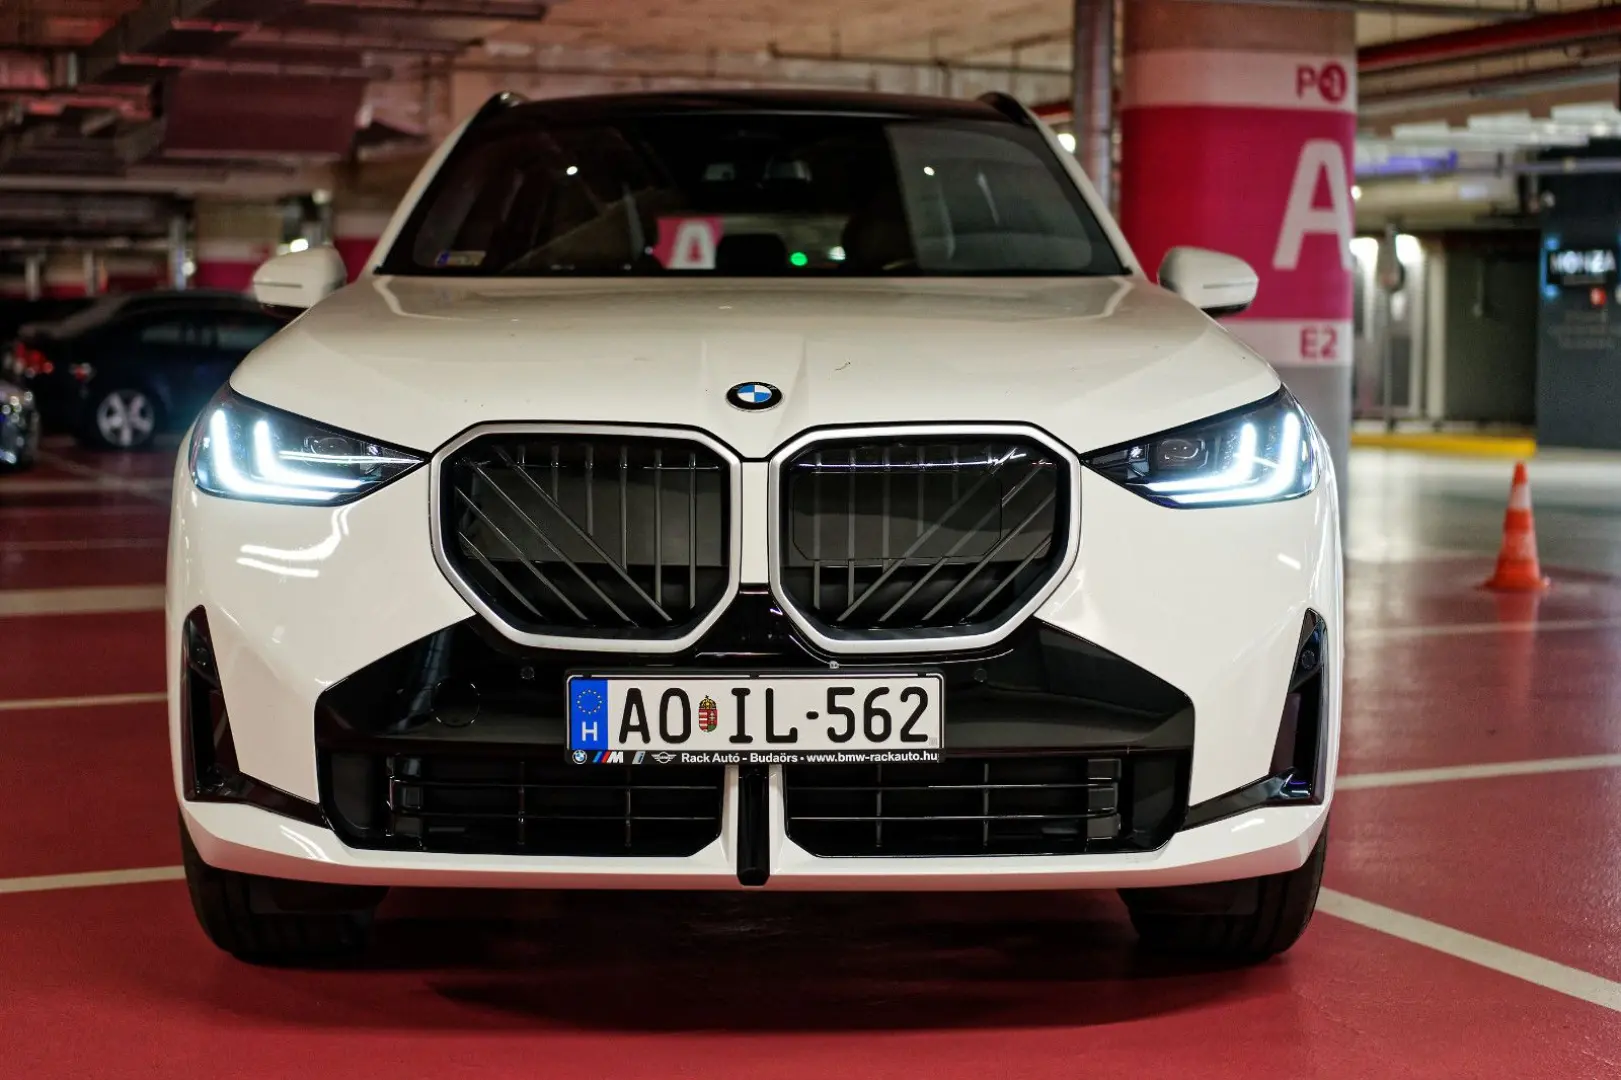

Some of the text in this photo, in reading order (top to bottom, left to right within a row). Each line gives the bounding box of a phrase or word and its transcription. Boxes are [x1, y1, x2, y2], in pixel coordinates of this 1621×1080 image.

[1272, 138, 1353, 270] A
[668, 221, 716, 269] A
[1300, 326, 1338, 359] E2
[581, 721, 598, 742] H
[619, 686, 929, 744] AO IL-562
[681, 753, 711, 763] Rack
[712, 752, 741, 763] Autó
[750, 752, 798, 763] Budaörs
[806, 750, 938, 763] www.bmw-rackauto.hu
